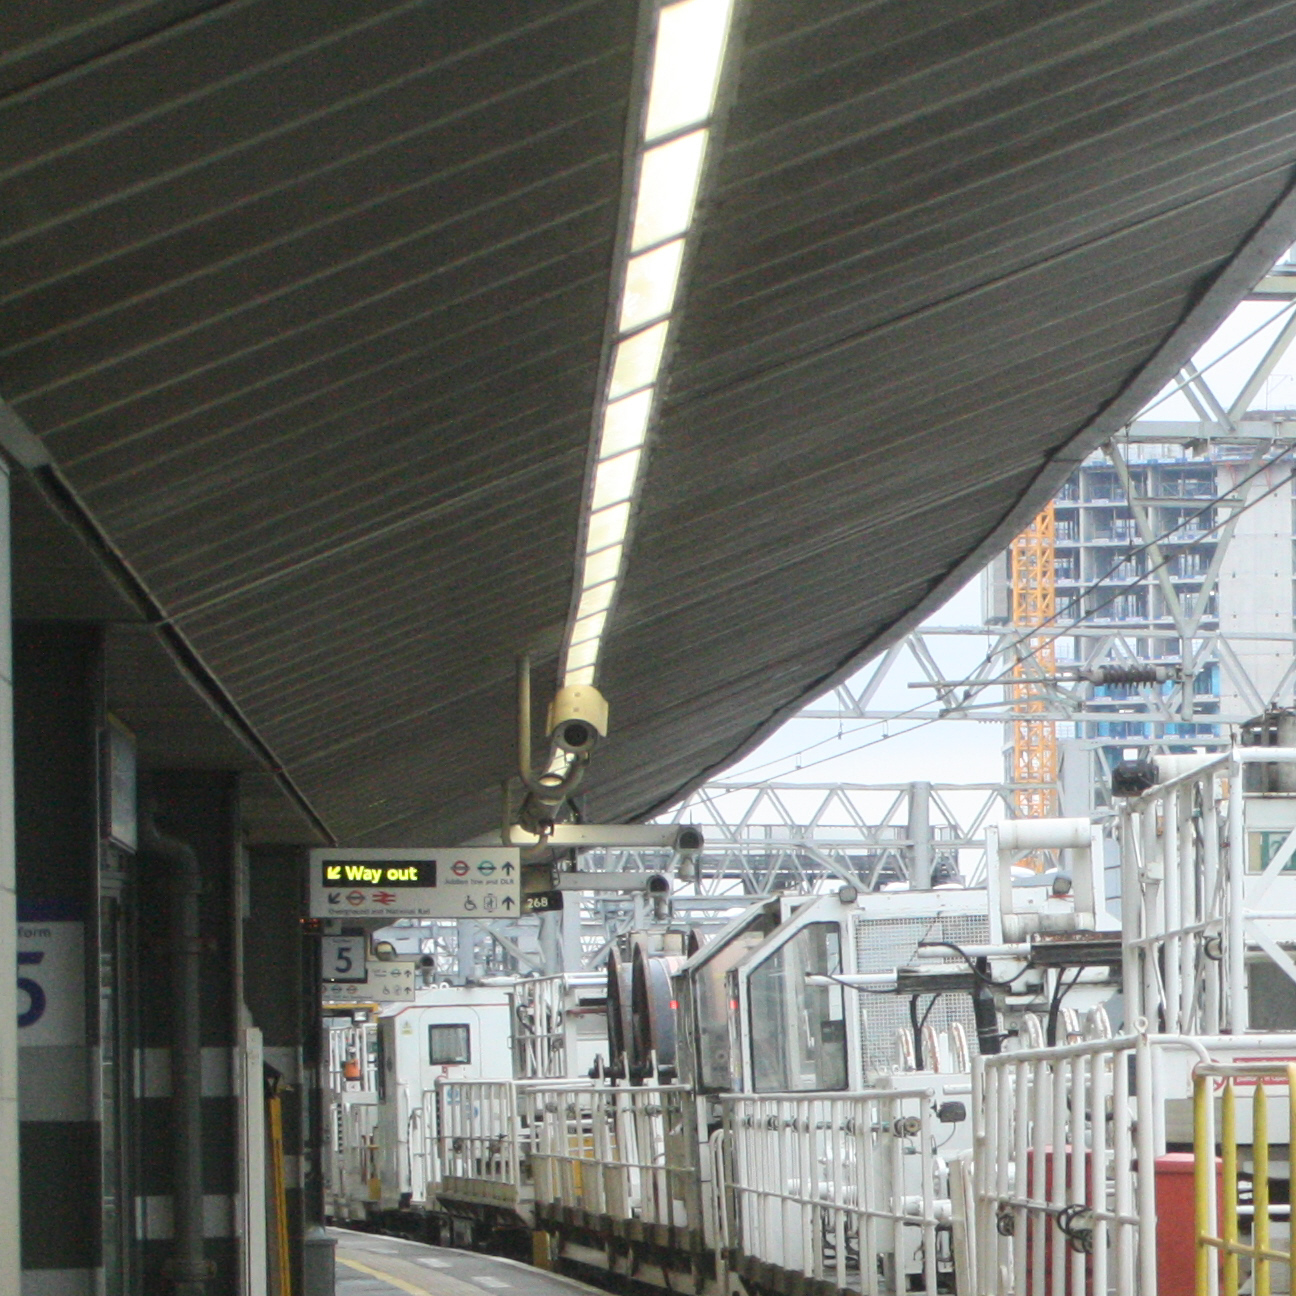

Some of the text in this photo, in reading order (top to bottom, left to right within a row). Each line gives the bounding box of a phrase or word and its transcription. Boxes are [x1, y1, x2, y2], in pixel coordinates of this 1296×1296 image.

[345, 865, 418, 884] Way out
[527, 897, 548, 908] 268
[17, 926, 51, 938] form
[335, 947, 352, 973] 5
[17, 951, 46, 1027] 5
